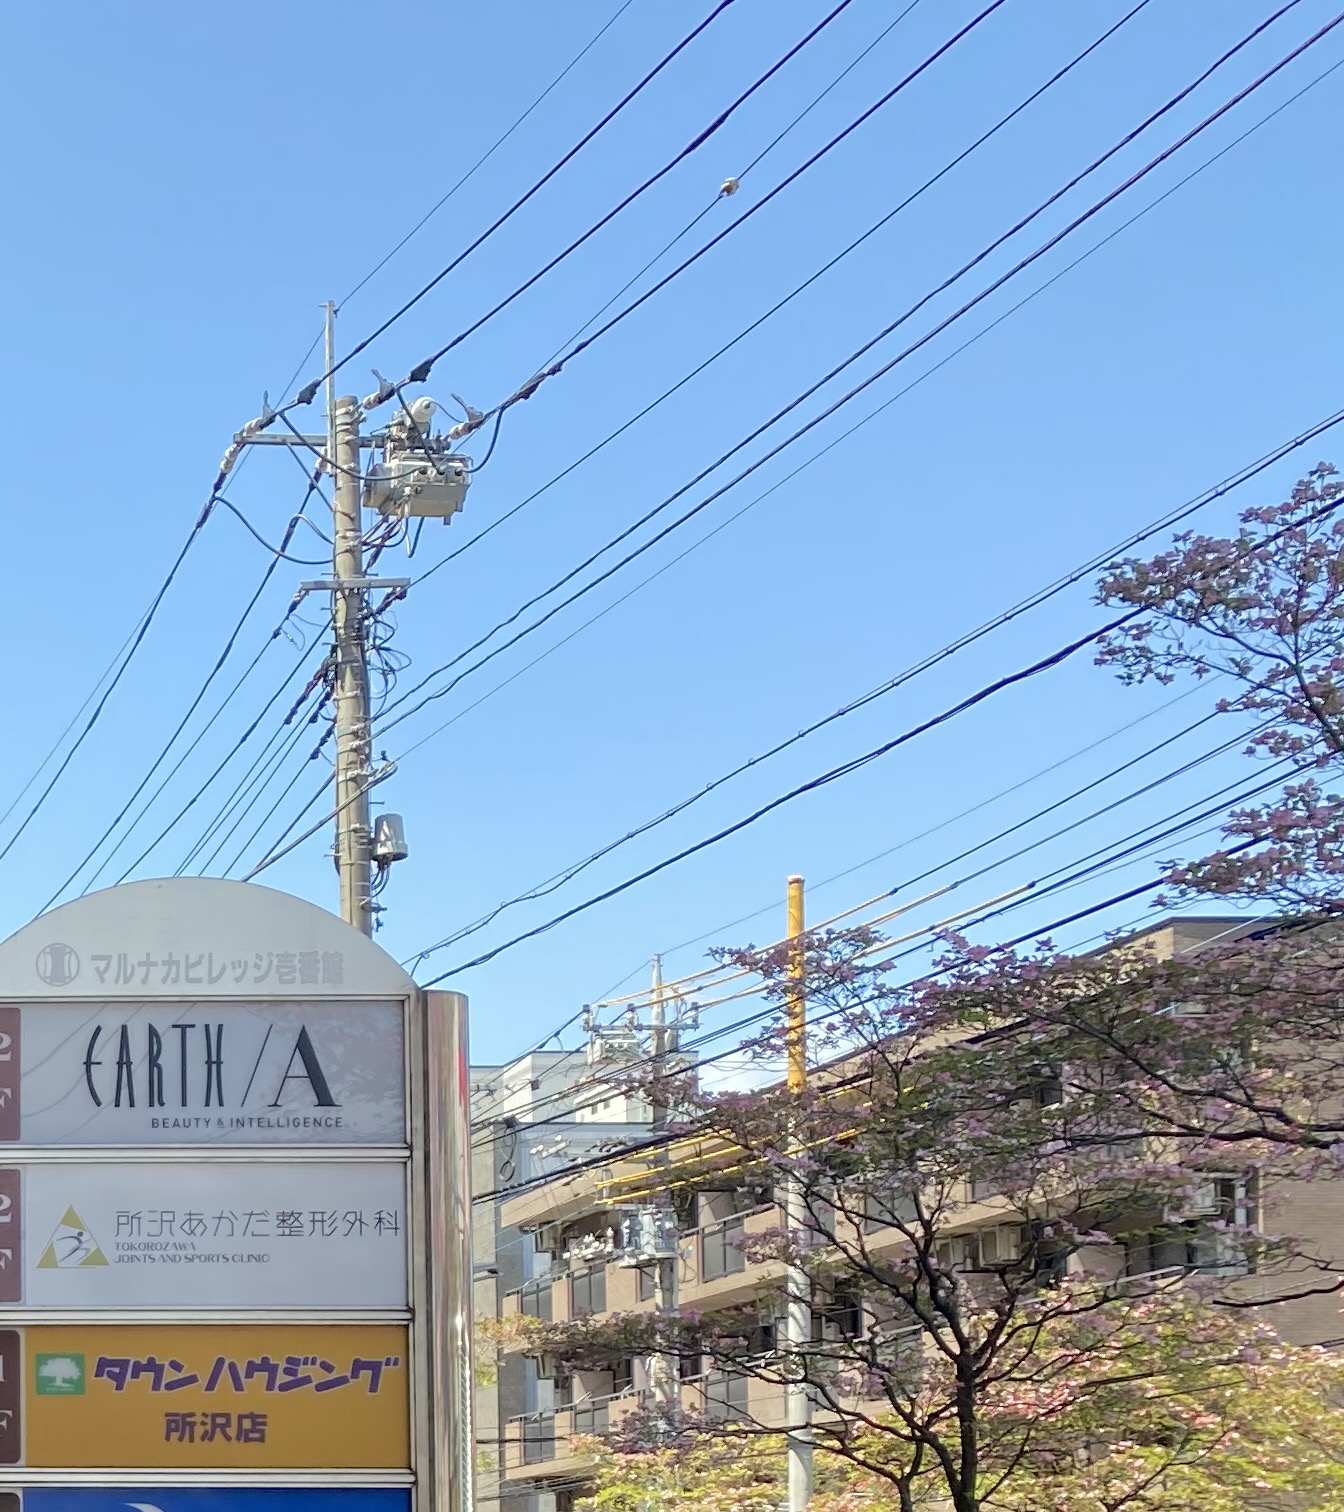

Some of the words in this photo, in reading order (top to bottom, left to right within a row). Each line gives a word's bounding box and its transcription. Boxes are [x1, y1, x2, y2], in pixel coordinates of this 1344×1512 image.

[90, 949, 345, 987] マルナカビレッジ壱番館
[151, 1116, 212, 1129] BEAUTY
[229, 1116, 344, 1129] INTELLIGENCE
[114, 1209, 401, 1238] 所沢あかだ整形外科
[114, 1241, 197, 1252] TOKOROZAWA
[113, 1253, 157, 1264] JOINTS
[158, 1253, 183, 1264] AND
[183, 1253, 230, 1264] SPORTS
[231, 1253, 271, 1264] CLINIC
[163, 1411, 268, 1444] 所沢店
